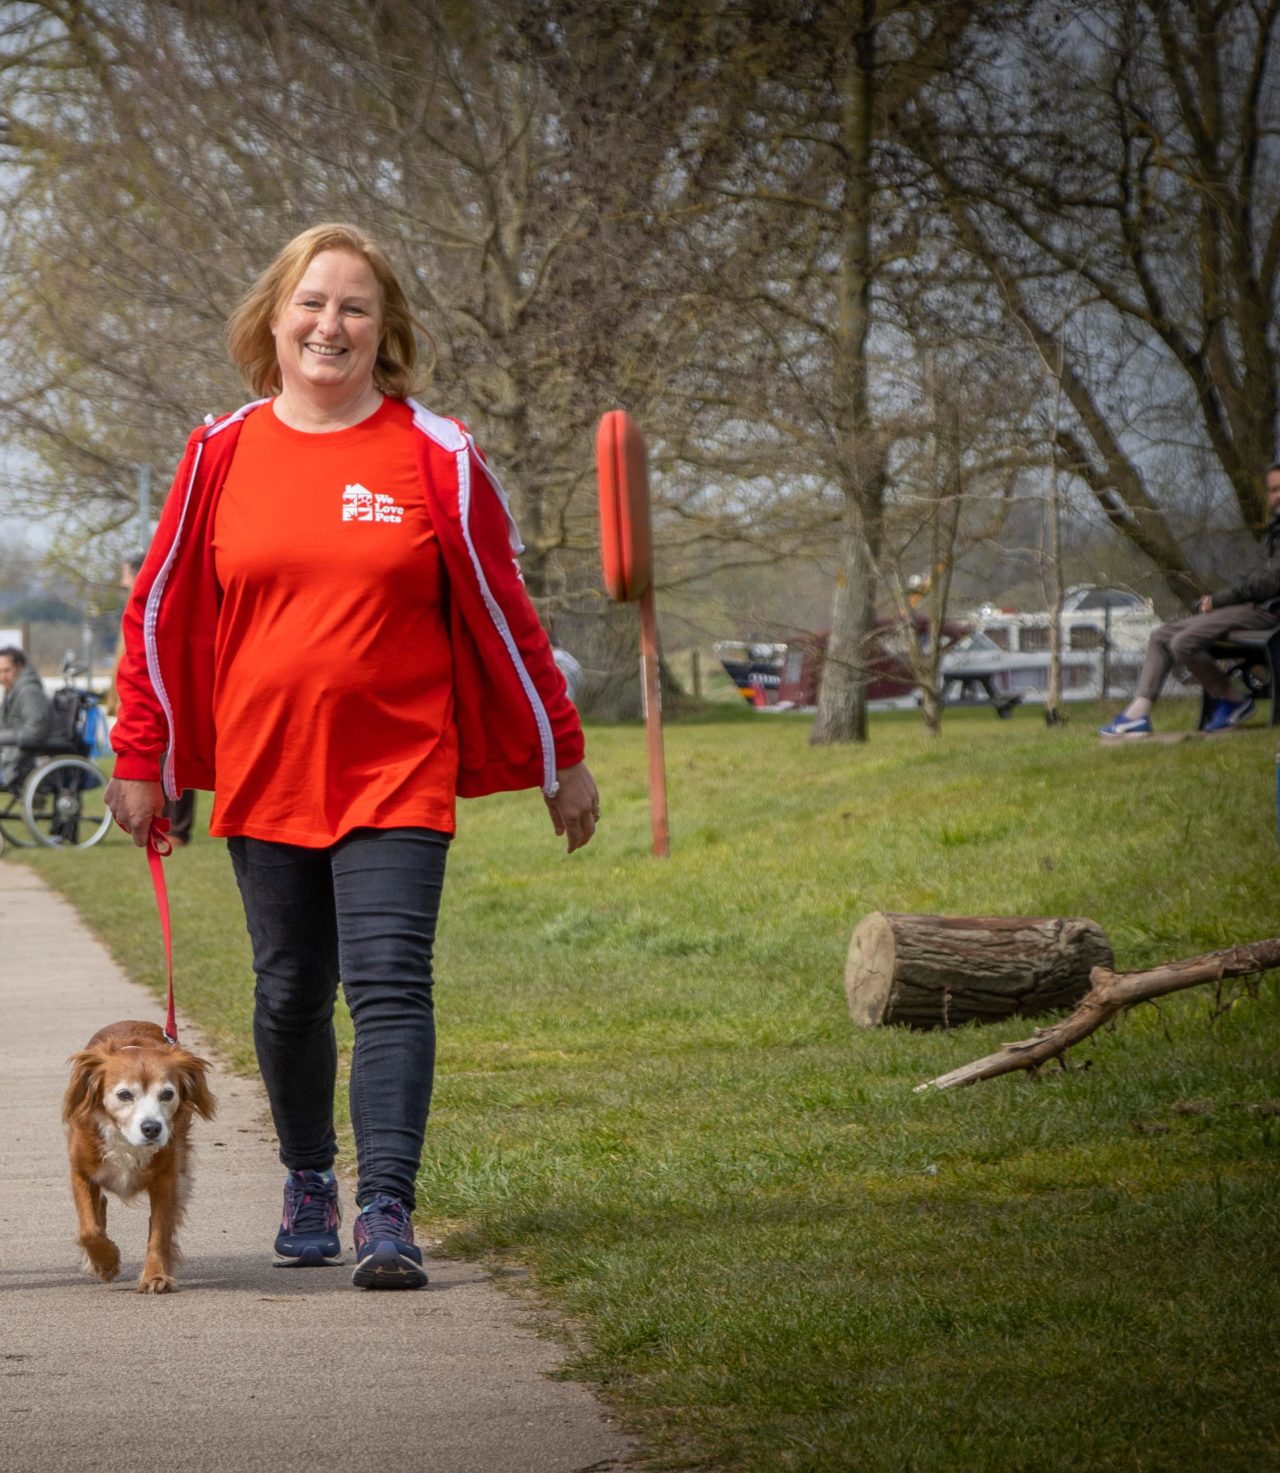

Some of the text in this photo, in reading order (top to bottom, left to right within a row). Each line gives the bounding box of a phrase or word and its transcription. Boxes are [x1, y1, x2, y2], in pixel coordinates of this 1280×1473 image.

[374, 494, 394, 504] We
[375, 499, 404, 515] Love
[375, 507, 402, 523] Pets
